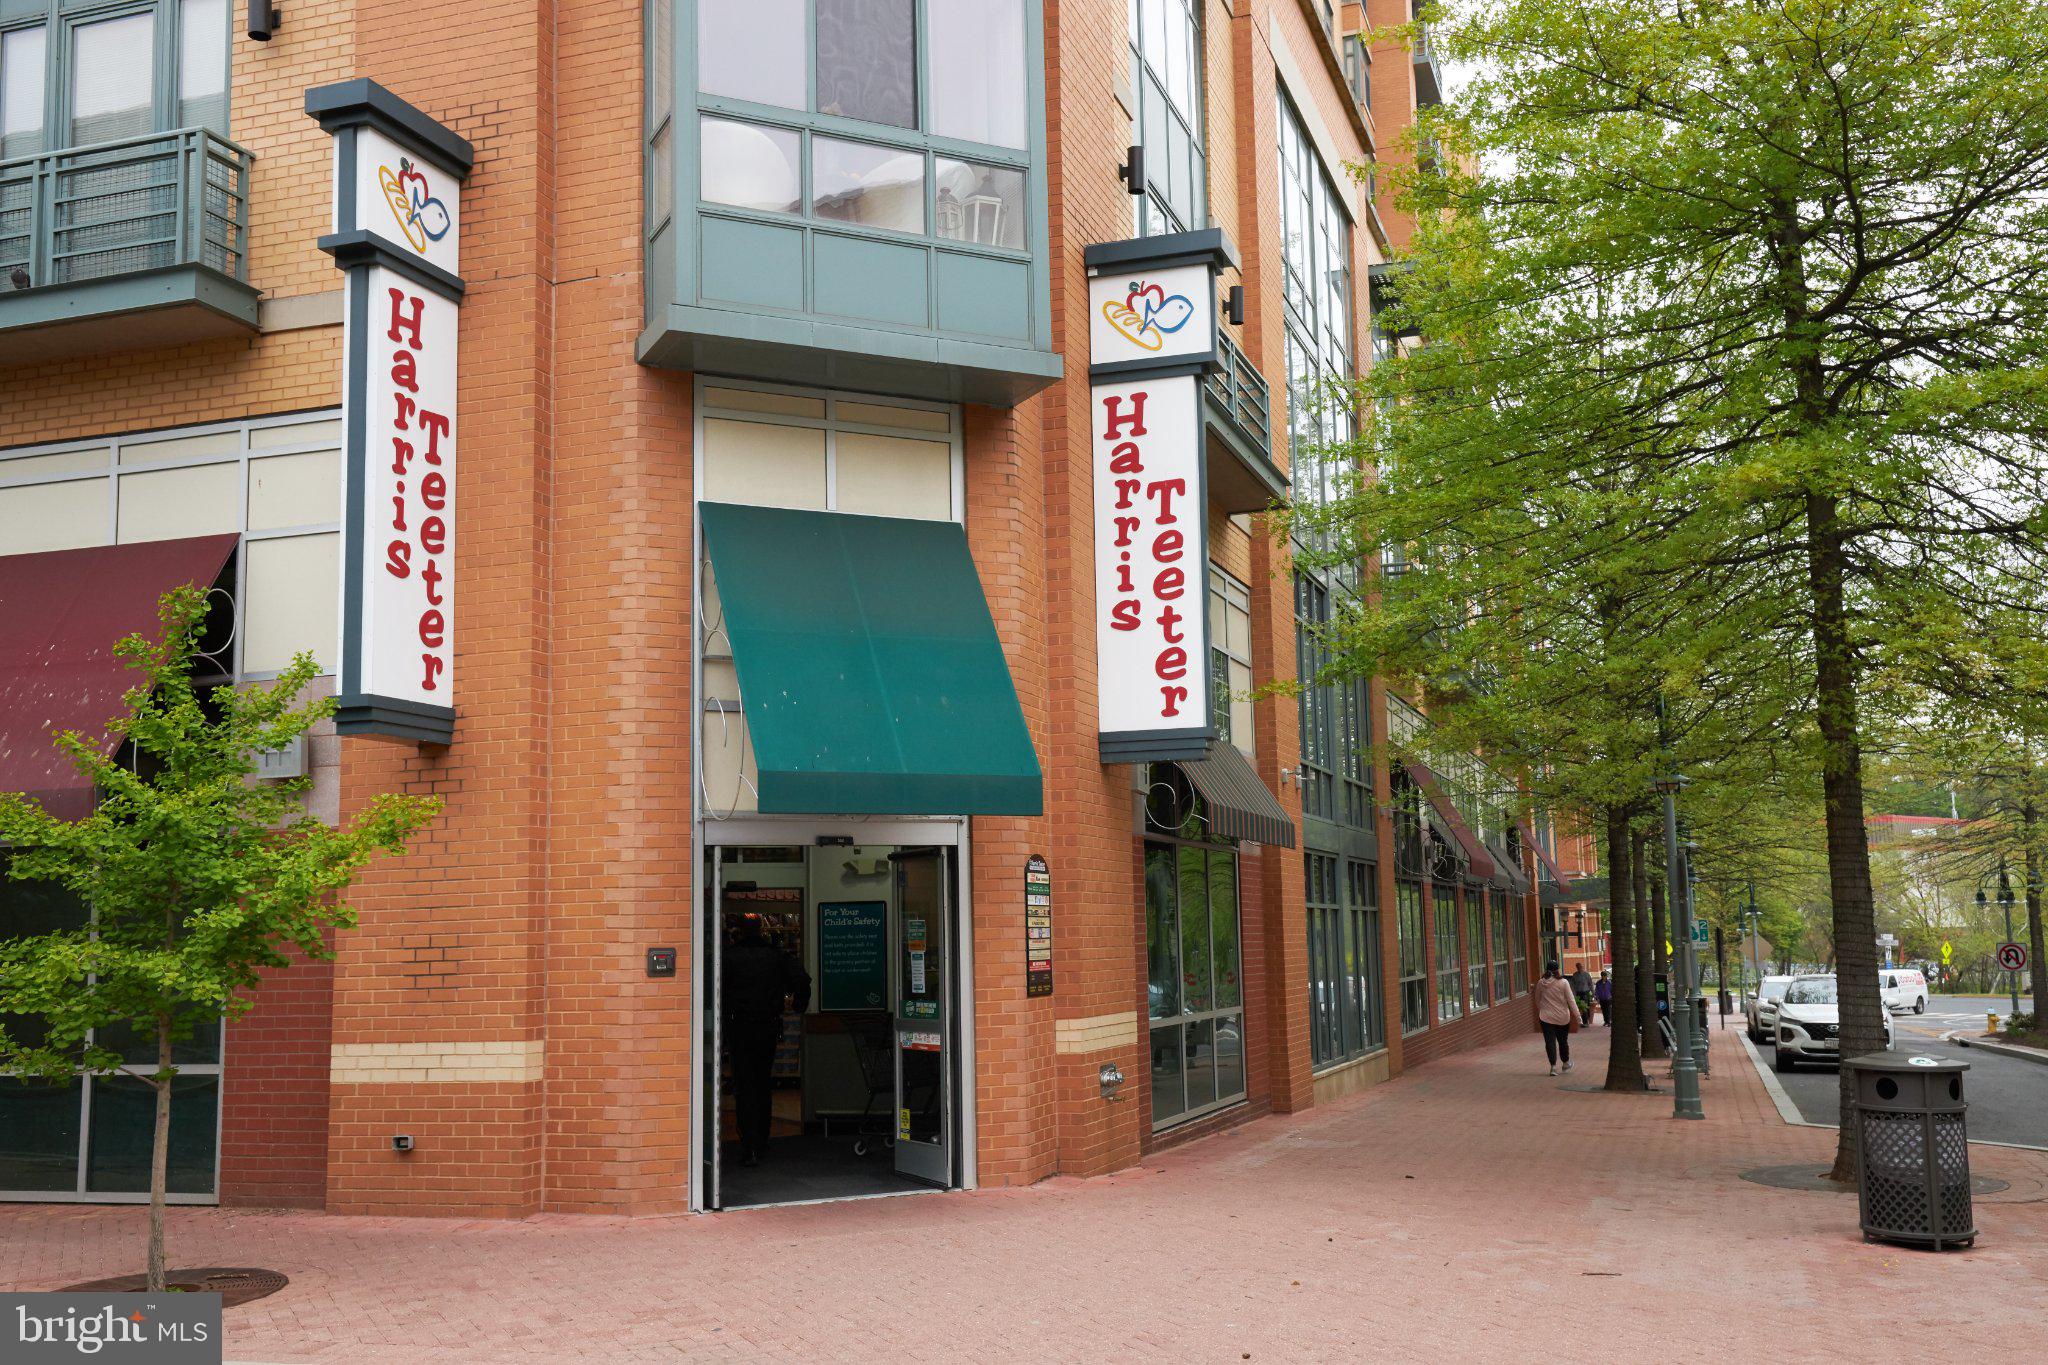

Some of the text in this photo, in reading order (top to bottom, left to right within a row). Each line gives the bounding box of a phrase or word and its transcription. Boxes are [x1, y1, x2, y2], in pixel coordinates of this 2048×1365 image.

[386, 287, 449, 691] Harris Teeter
[1103, 391, 1188, 718] Harris Teeter
[824, 917, 880, 927] Child's Safety
[840, 908, 859, 916] Your
